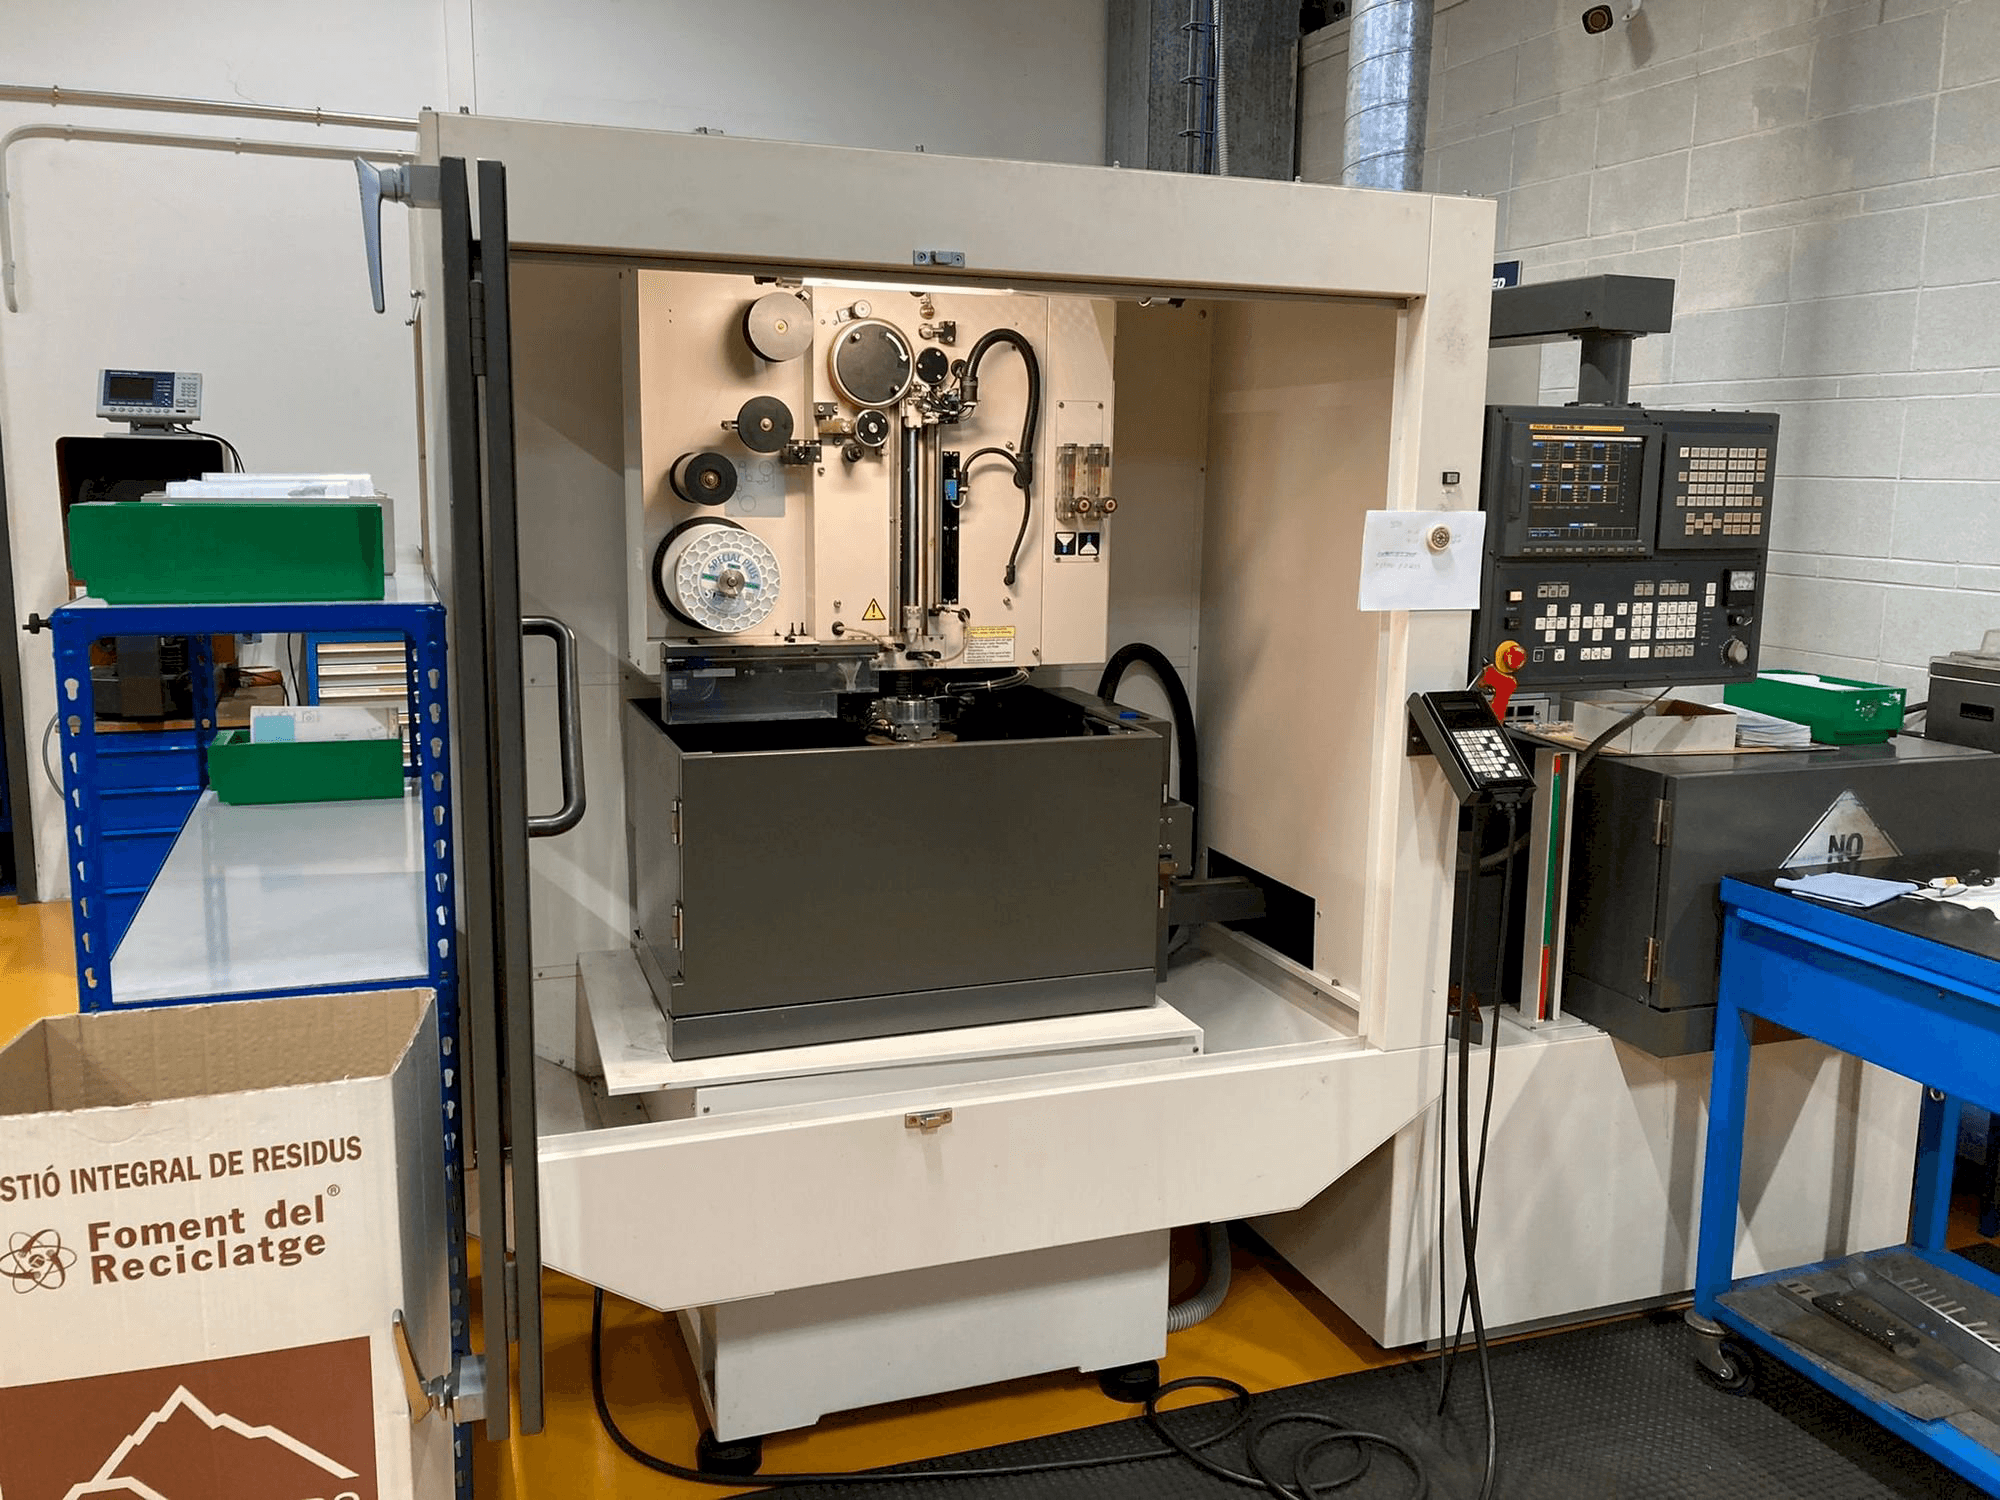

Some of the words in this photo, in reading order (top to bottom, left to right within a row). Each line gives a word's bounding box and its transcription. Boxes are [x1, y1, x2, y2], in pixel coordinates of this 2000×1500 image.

[708, 553, 741, 571] SPECIAL
[742, 558, 759, 580] PLUS
[0, 1165, 60, 1202] STIÓ
[70, 1156, 201, 1195] INTEGRAL
[209, 1150, 244, 1178] DE
[252, 1136, 362, 1173] RESIDUS
[88, 1208, 245, 1252] Foment
[264, 1194, 324, 1230] del
[91, 1234, 326, 1284] Reciclatge
